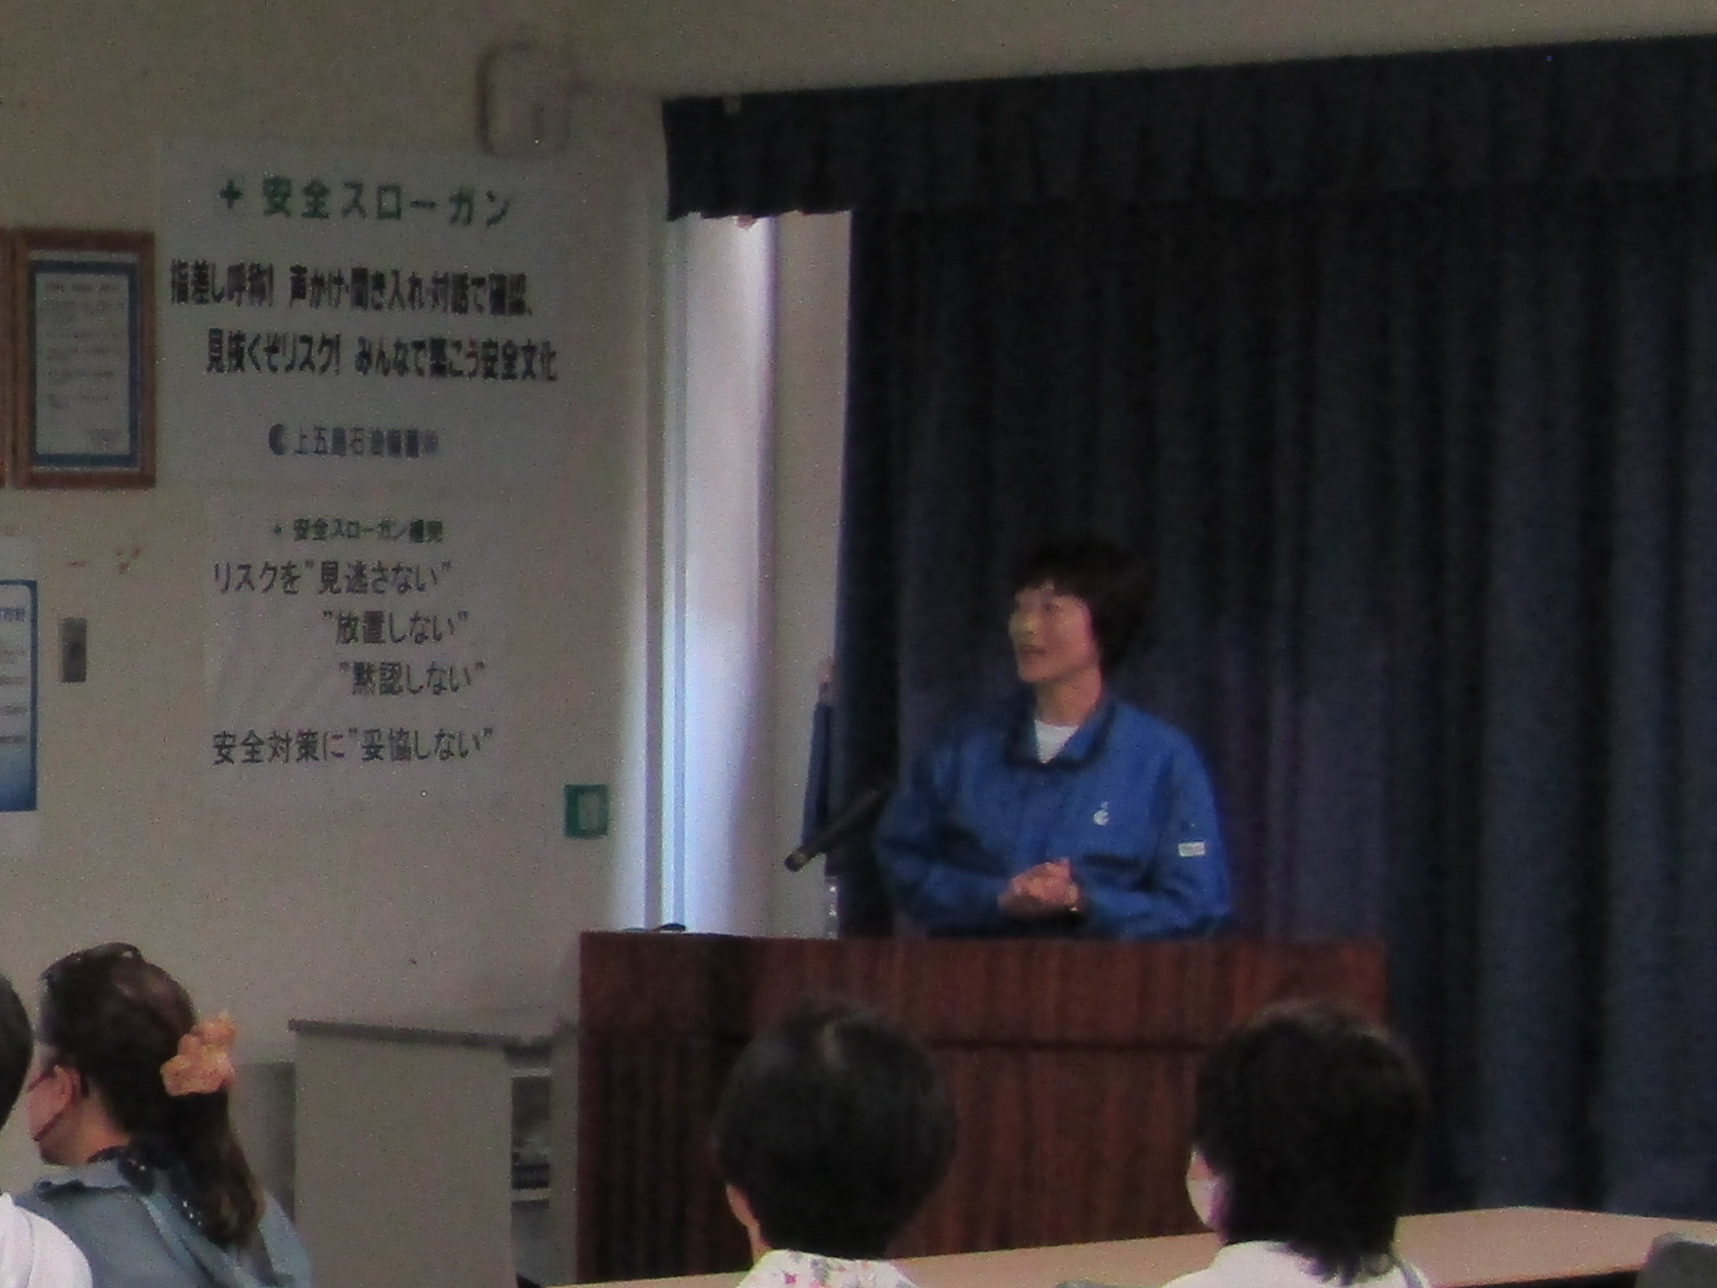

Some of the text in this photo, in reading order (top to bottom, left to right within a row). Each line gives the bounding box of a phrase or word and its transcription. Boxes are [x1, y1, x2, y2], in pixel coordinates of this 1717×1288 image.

[261, 172, 513, 228] 安全スローガン
